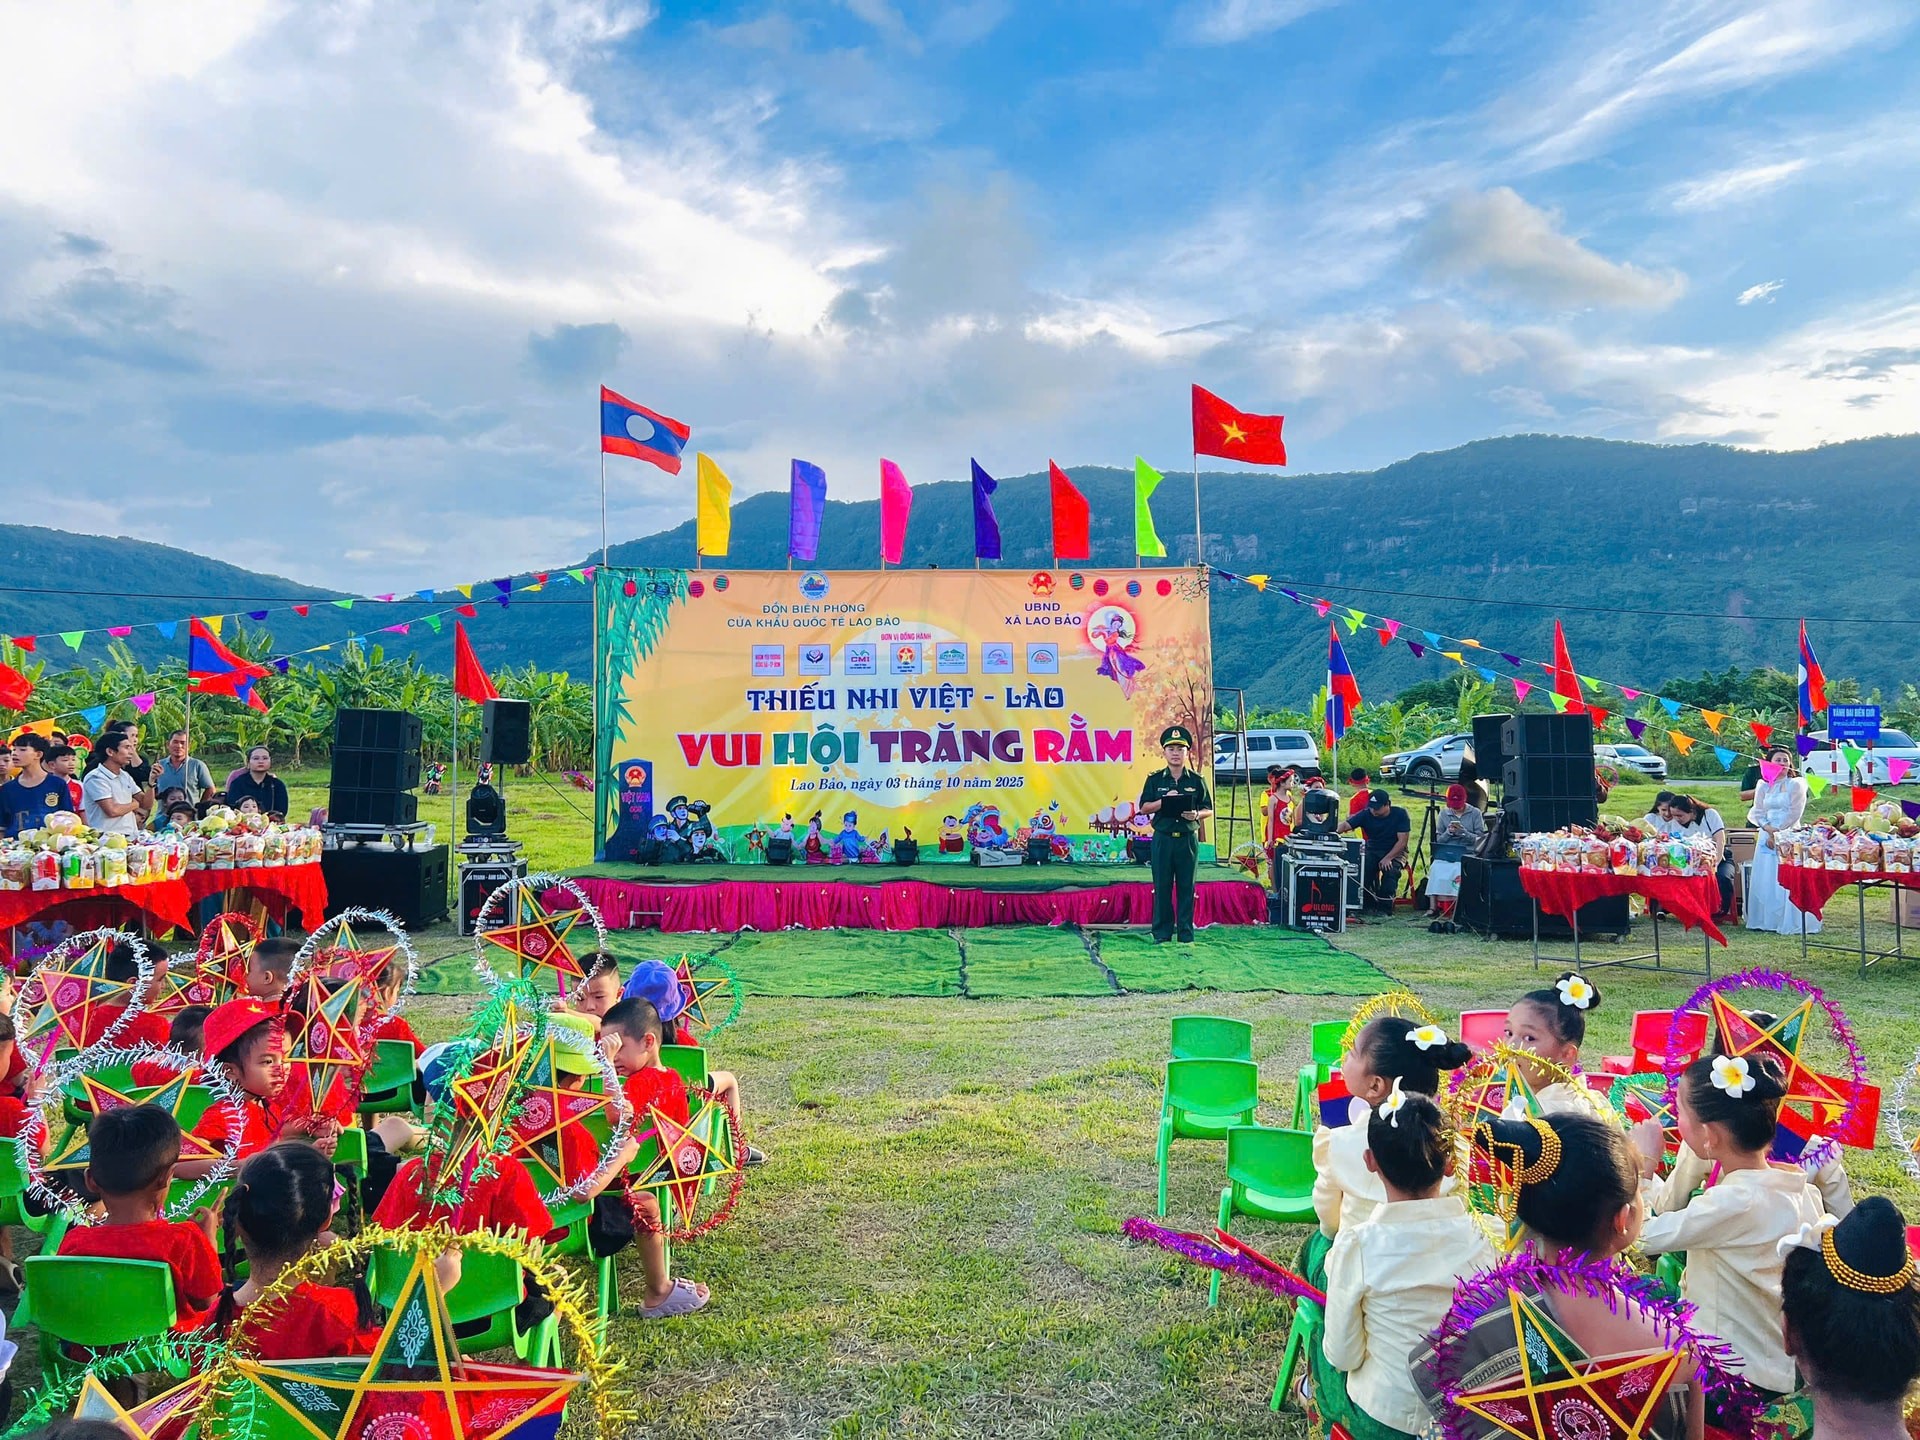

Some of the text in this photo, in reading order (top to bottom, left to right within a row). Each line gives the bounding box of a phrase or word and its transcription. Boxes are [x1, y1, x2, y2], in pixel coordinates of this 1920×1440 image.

[792, 602, 820, 613] BIÊN
[1024, 602, 1061, 612] UBND
[727, 615, 752, 627] CỬA
[756, 613, 789, 627] KHẨU
[793, 615, 827, 627] QUỐC
[849, 617, 872, 627] LAO
[875, 613, 901, 626] BẢO
[1005, 613, 1082, 625] XÃ LAO BẢO
[747, 681, 836, 711] THIẾU
[847, 688, 899, 709] NHI
[908, 682, 974, 713] VIỆT
[1005, 682, 1064, 708] LÀO
[677, 713, 1132, 772] VUI HỘI TRĂNG RẰM
[790, 776, 1024, 791] Lao Bảo, ngày 03 tháng 10 năm 2025
